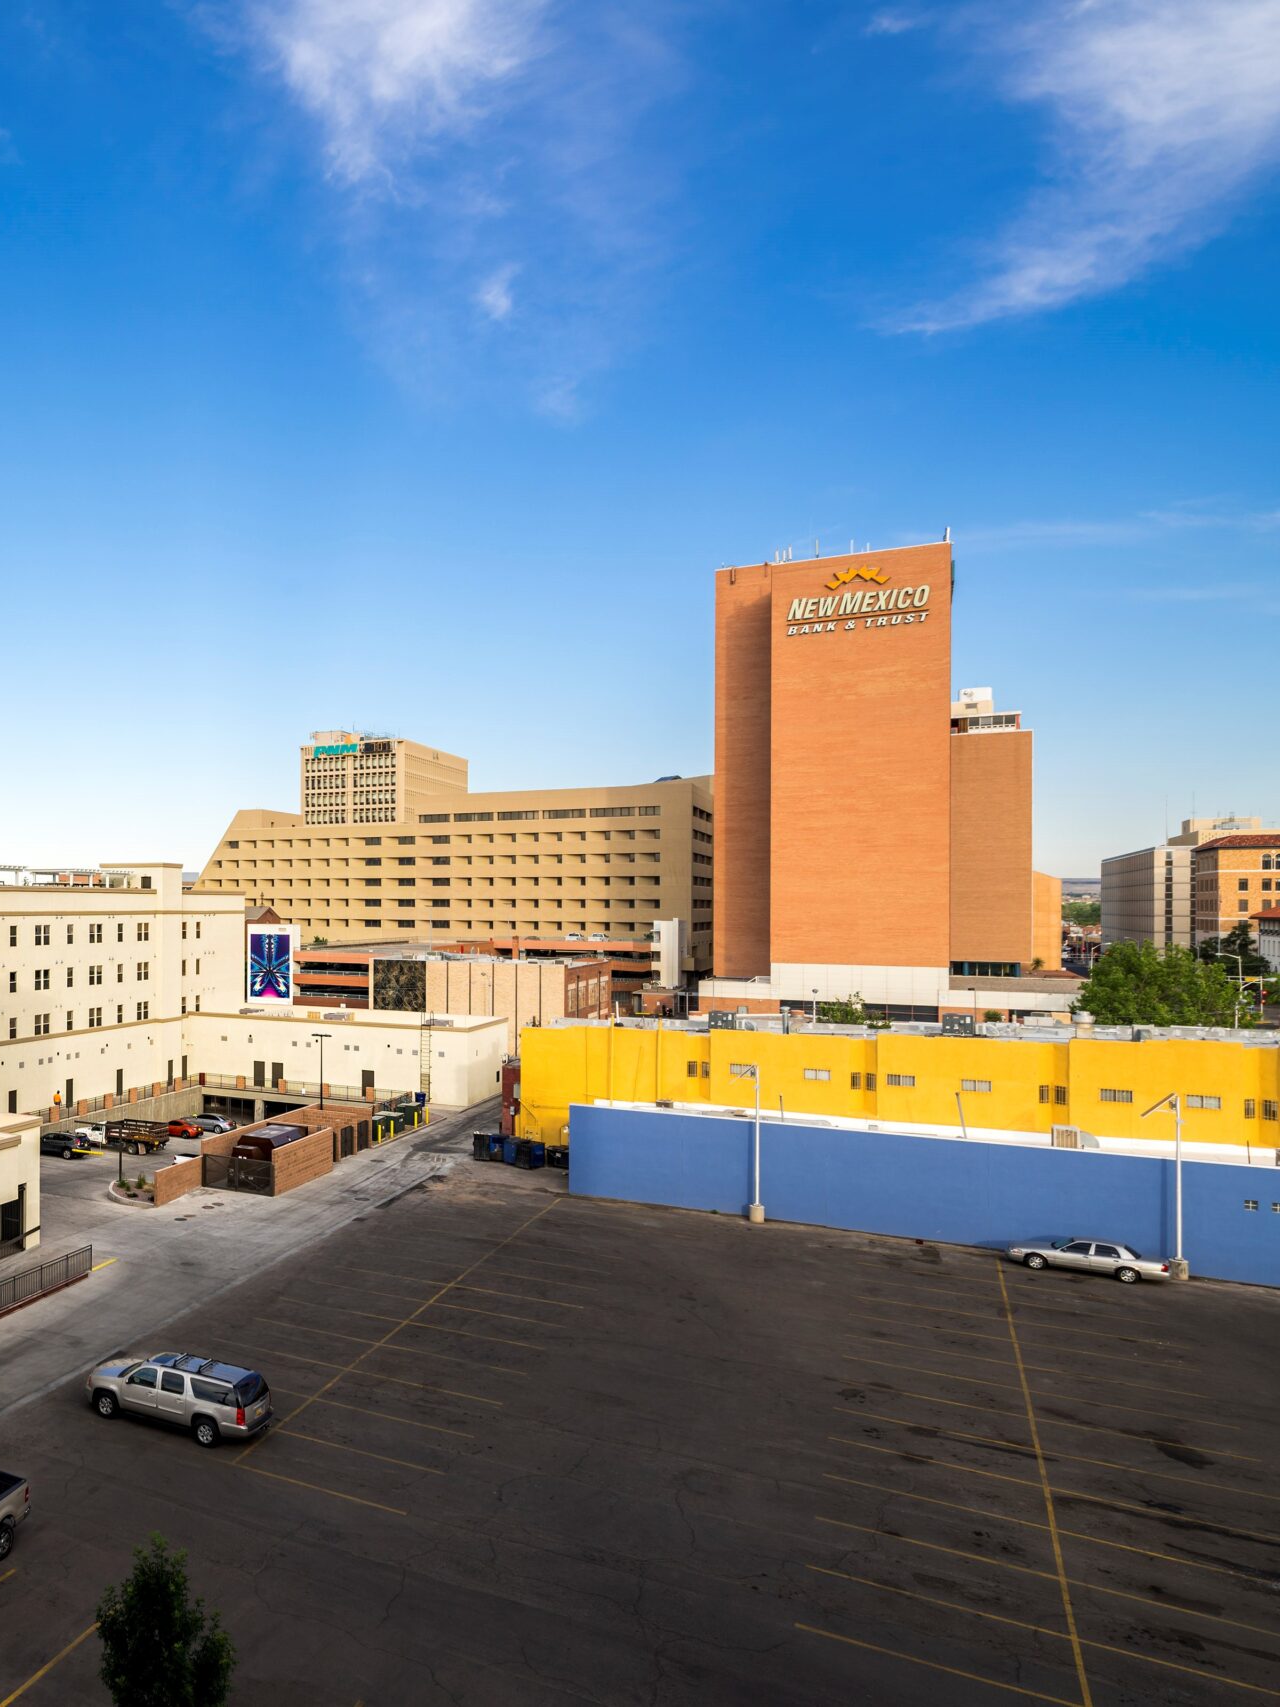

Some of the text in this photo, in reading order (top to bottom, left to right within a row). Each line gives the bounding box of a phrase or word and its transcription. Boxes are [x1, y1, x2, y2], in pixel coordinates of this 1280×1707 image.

[787, 585, 931, 621] NEW MEXICO
[787, 612, 929, 636] BANK & TRUST
[313, 743, 358, 759] PNM
